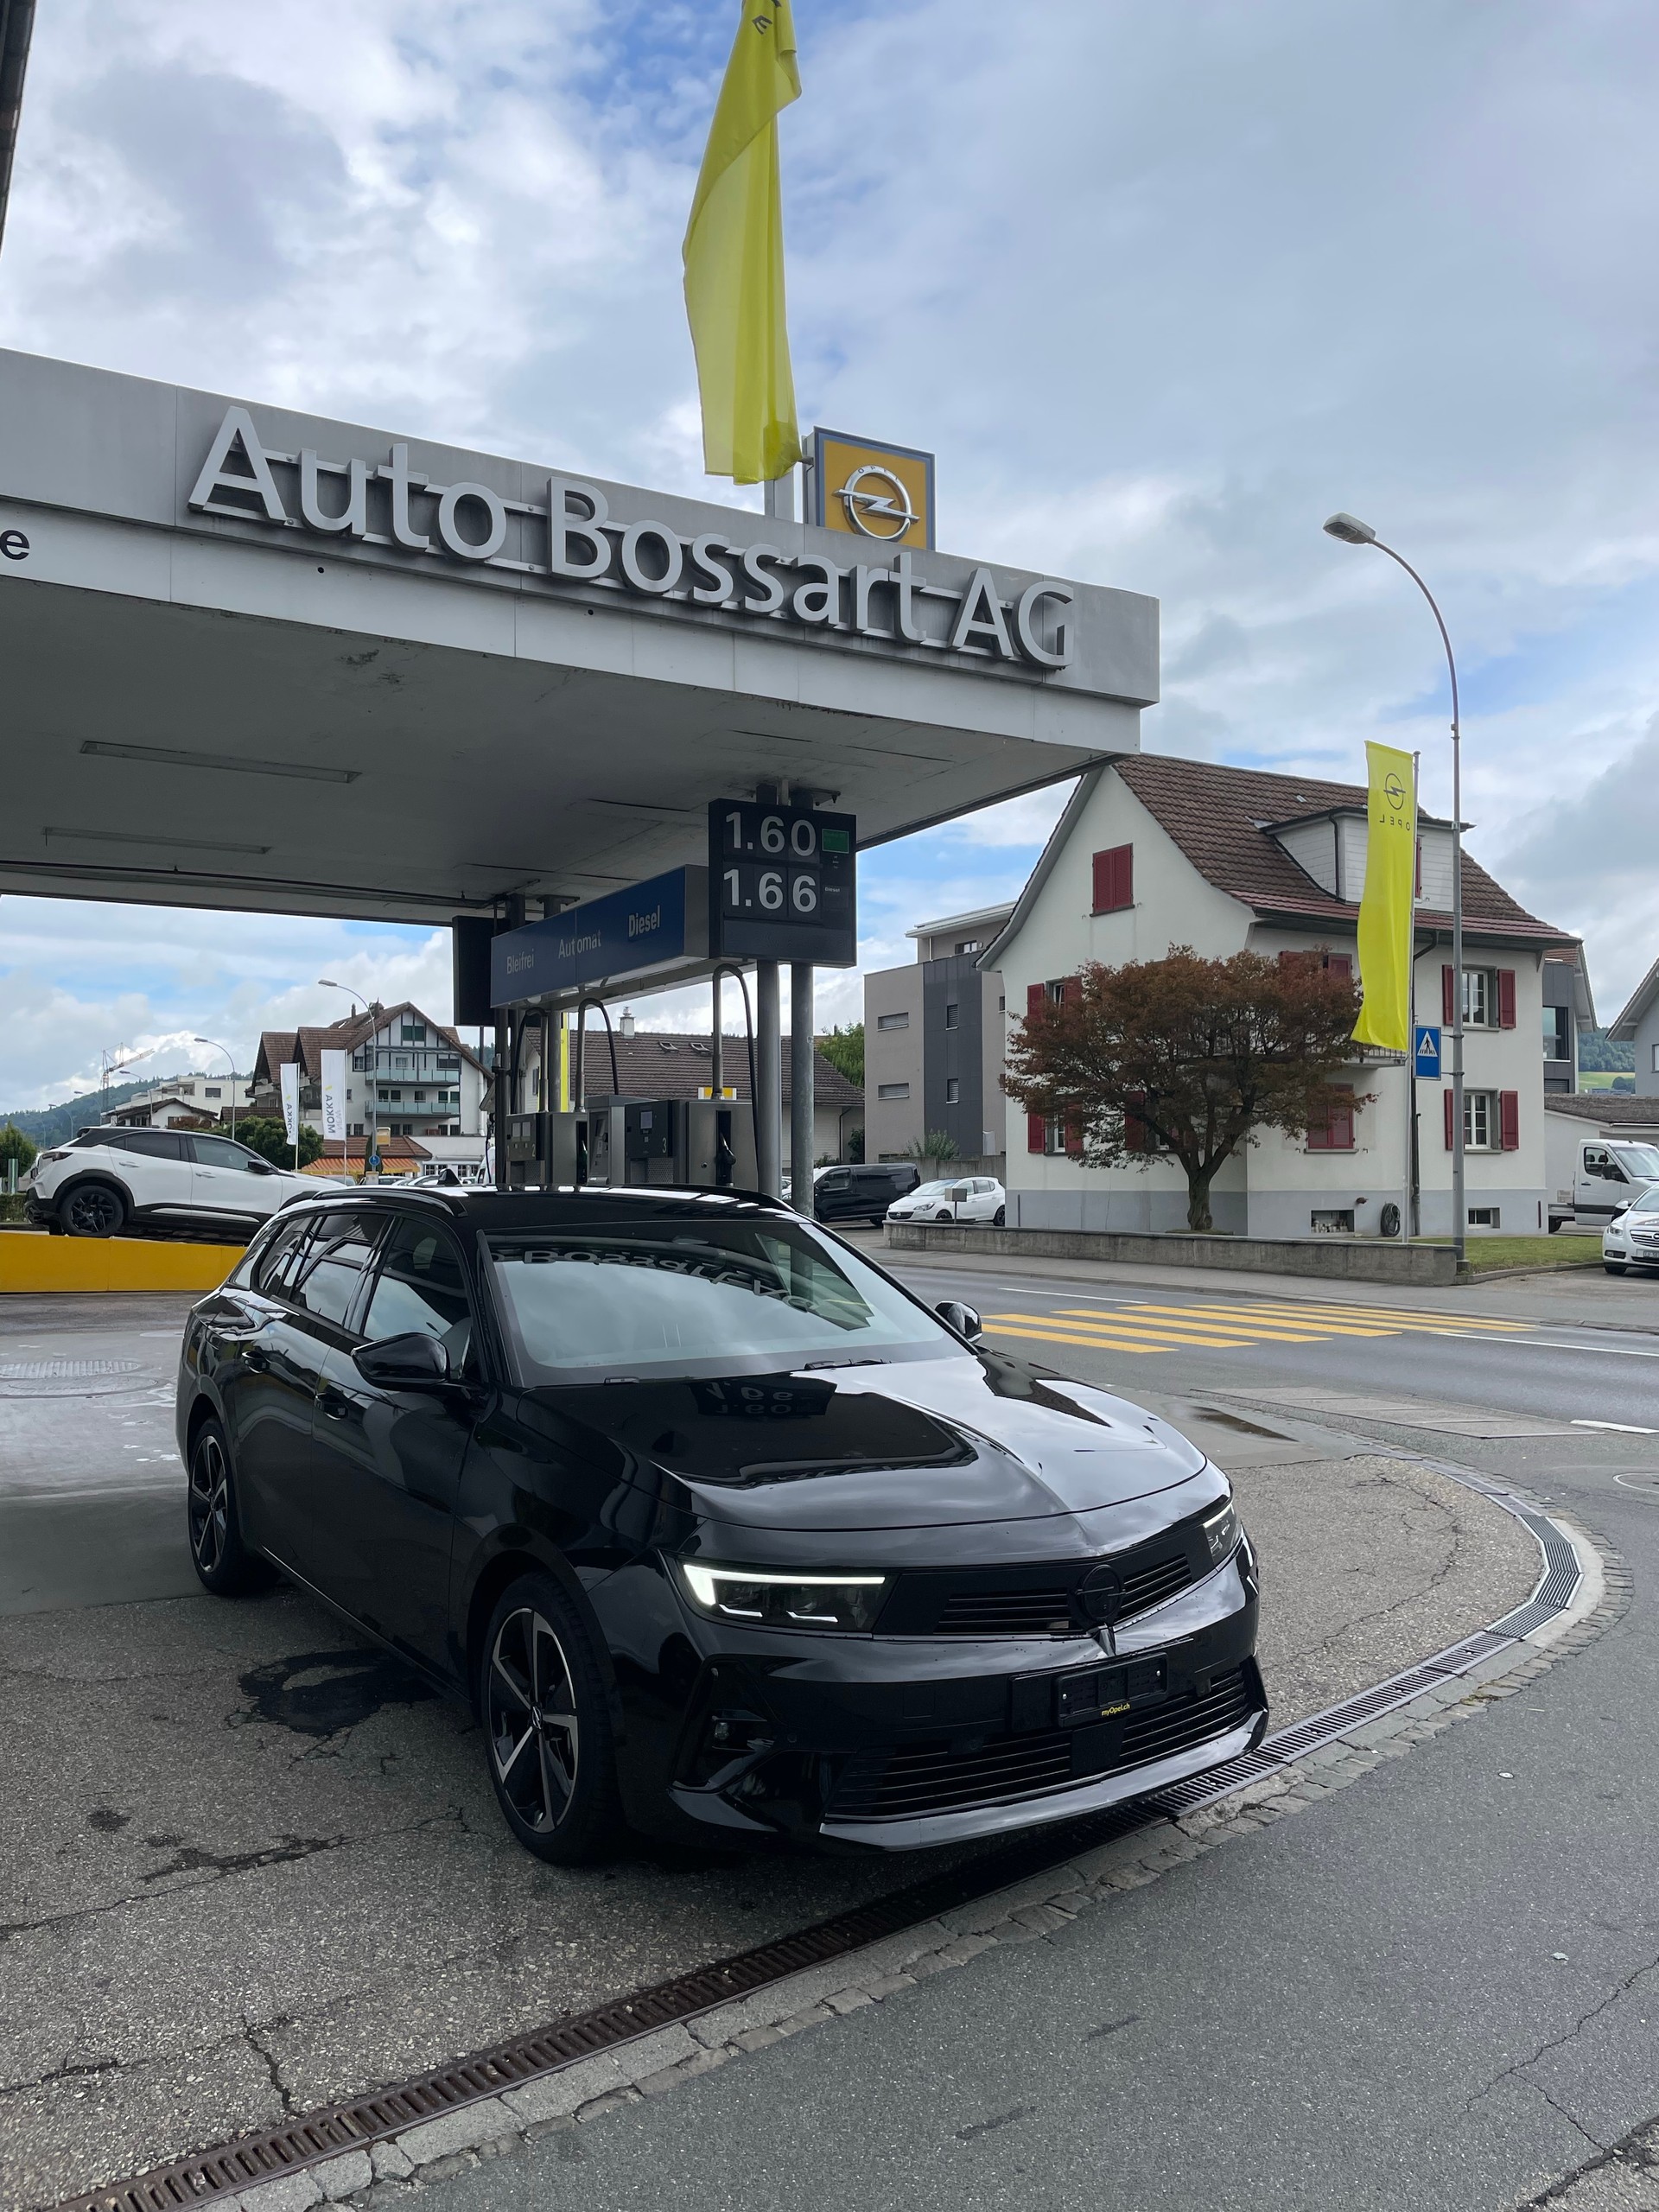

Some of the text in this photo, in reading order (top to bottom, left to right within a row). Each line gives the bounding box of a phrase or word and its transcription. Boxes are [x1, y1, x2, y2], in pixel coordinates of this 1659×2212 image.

[188, 405, 1075, 669] Auto Bossart AG
[726, 811, 817, 857] 1.60
[723, 868, 817, 912] 1.66
[506, 905, 661, 975] Bleifrei Automat Diesel
[662, 1137, 667, 1154] 3
[1102, 1703, 1130, 1716] myOpel.ch
